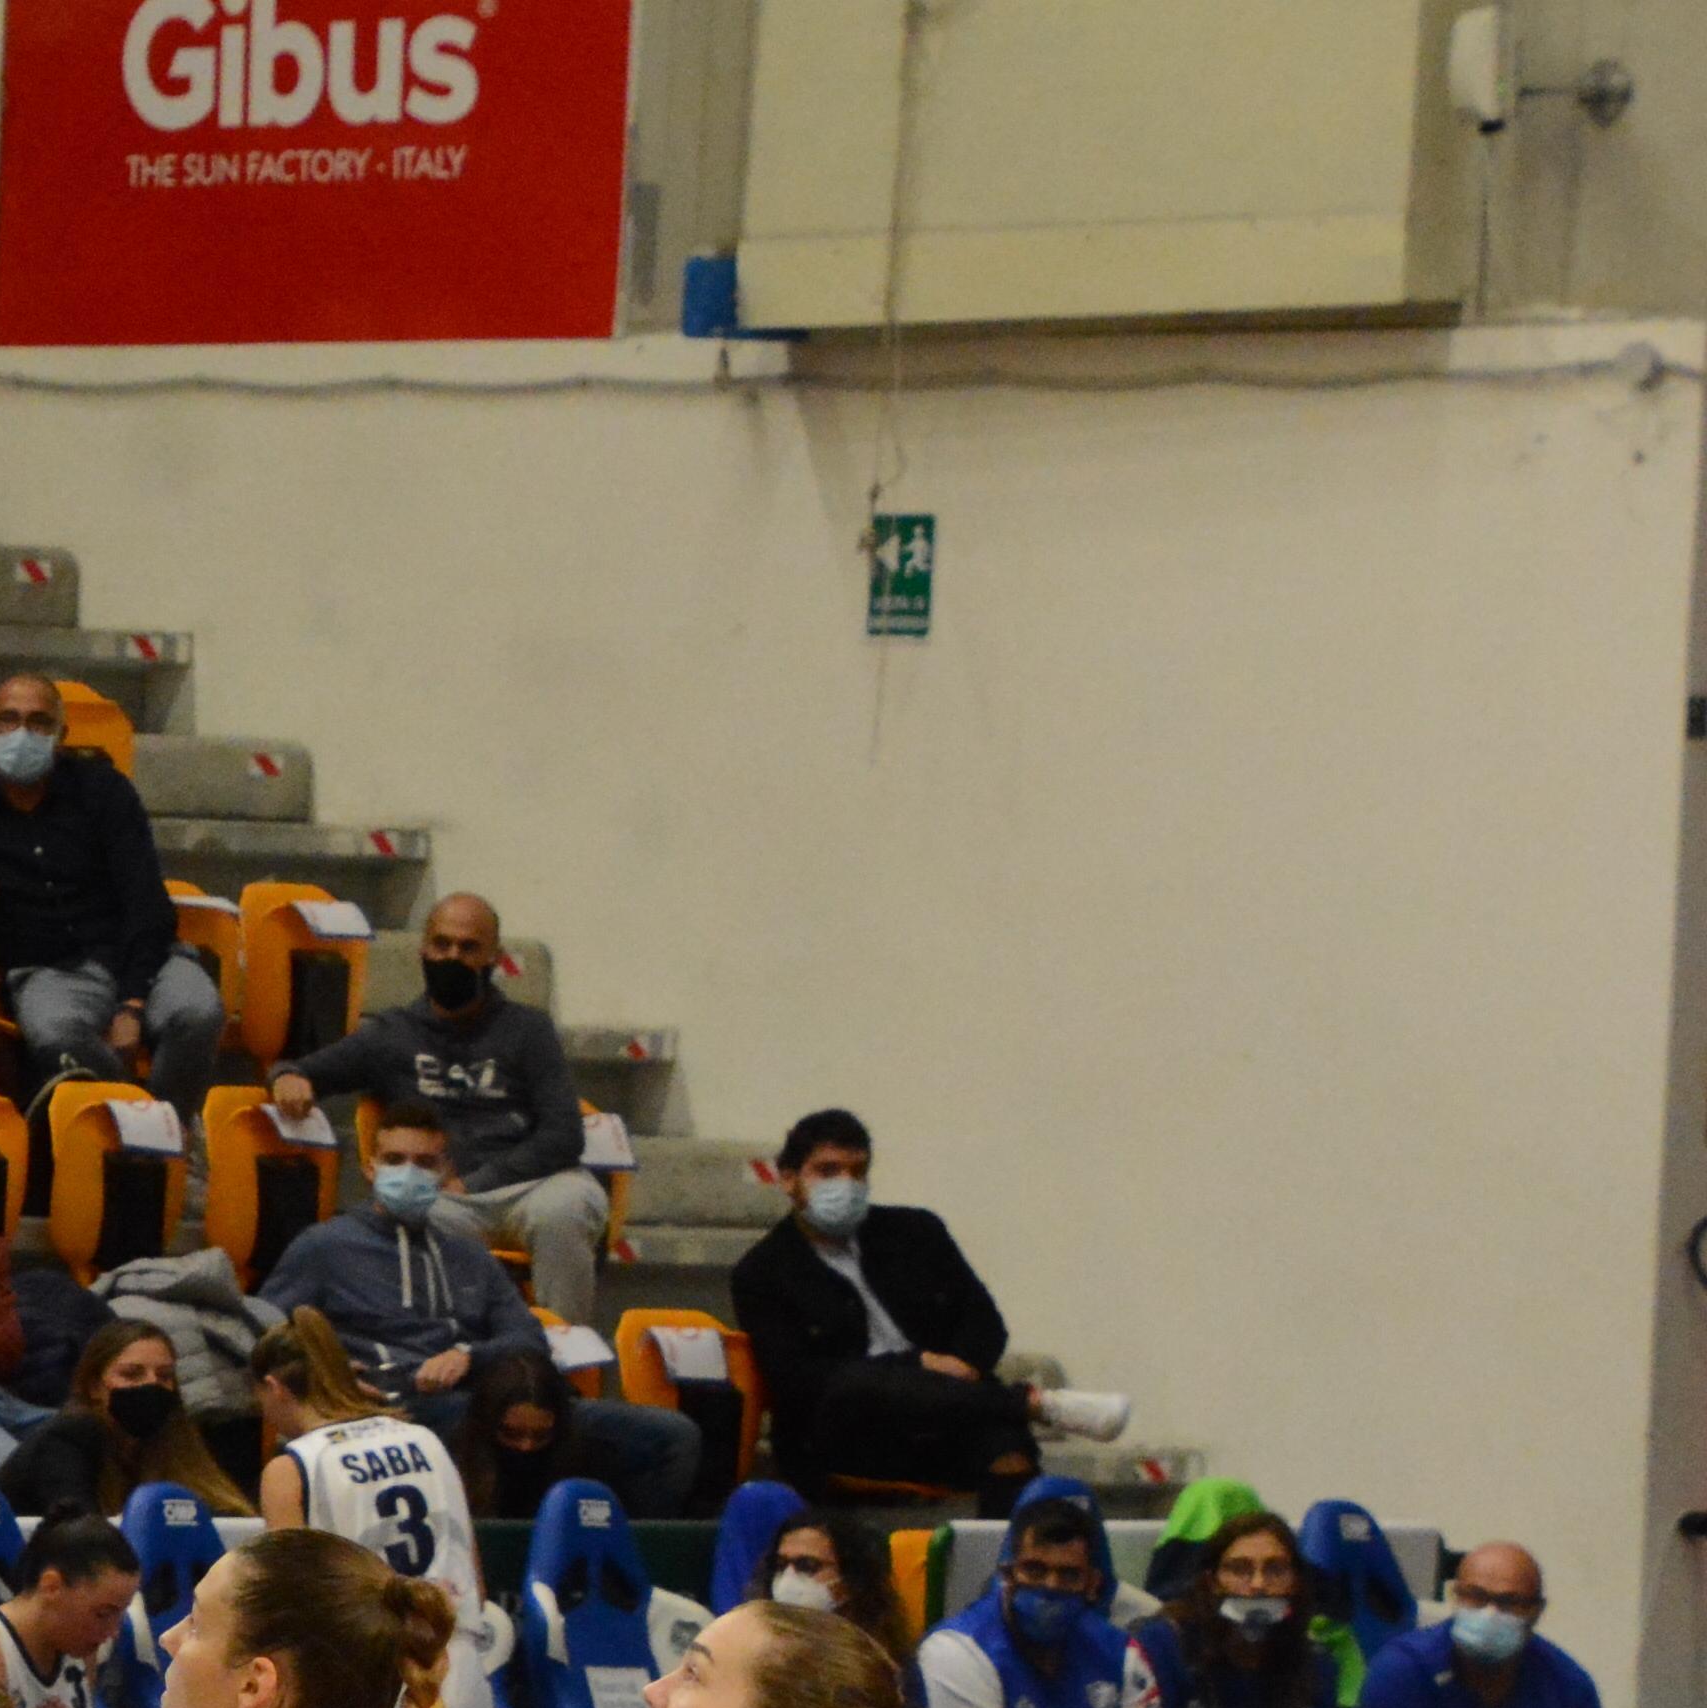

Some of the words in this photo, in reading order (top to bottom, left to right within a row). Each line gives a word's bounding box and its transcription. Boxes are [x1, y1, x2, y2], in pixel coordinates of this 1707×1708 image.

[122, 0, 479, 131] Gibus
[127, 154, 176, 188] THE
[181, 151, 242, 186] SUN
[247, 147, 373, 187] FACTORY
[391, 145, 468, 181] ITALY
[341, 1443, 432, 1484] SABA
[375, 1484, 436, 1577] 3
